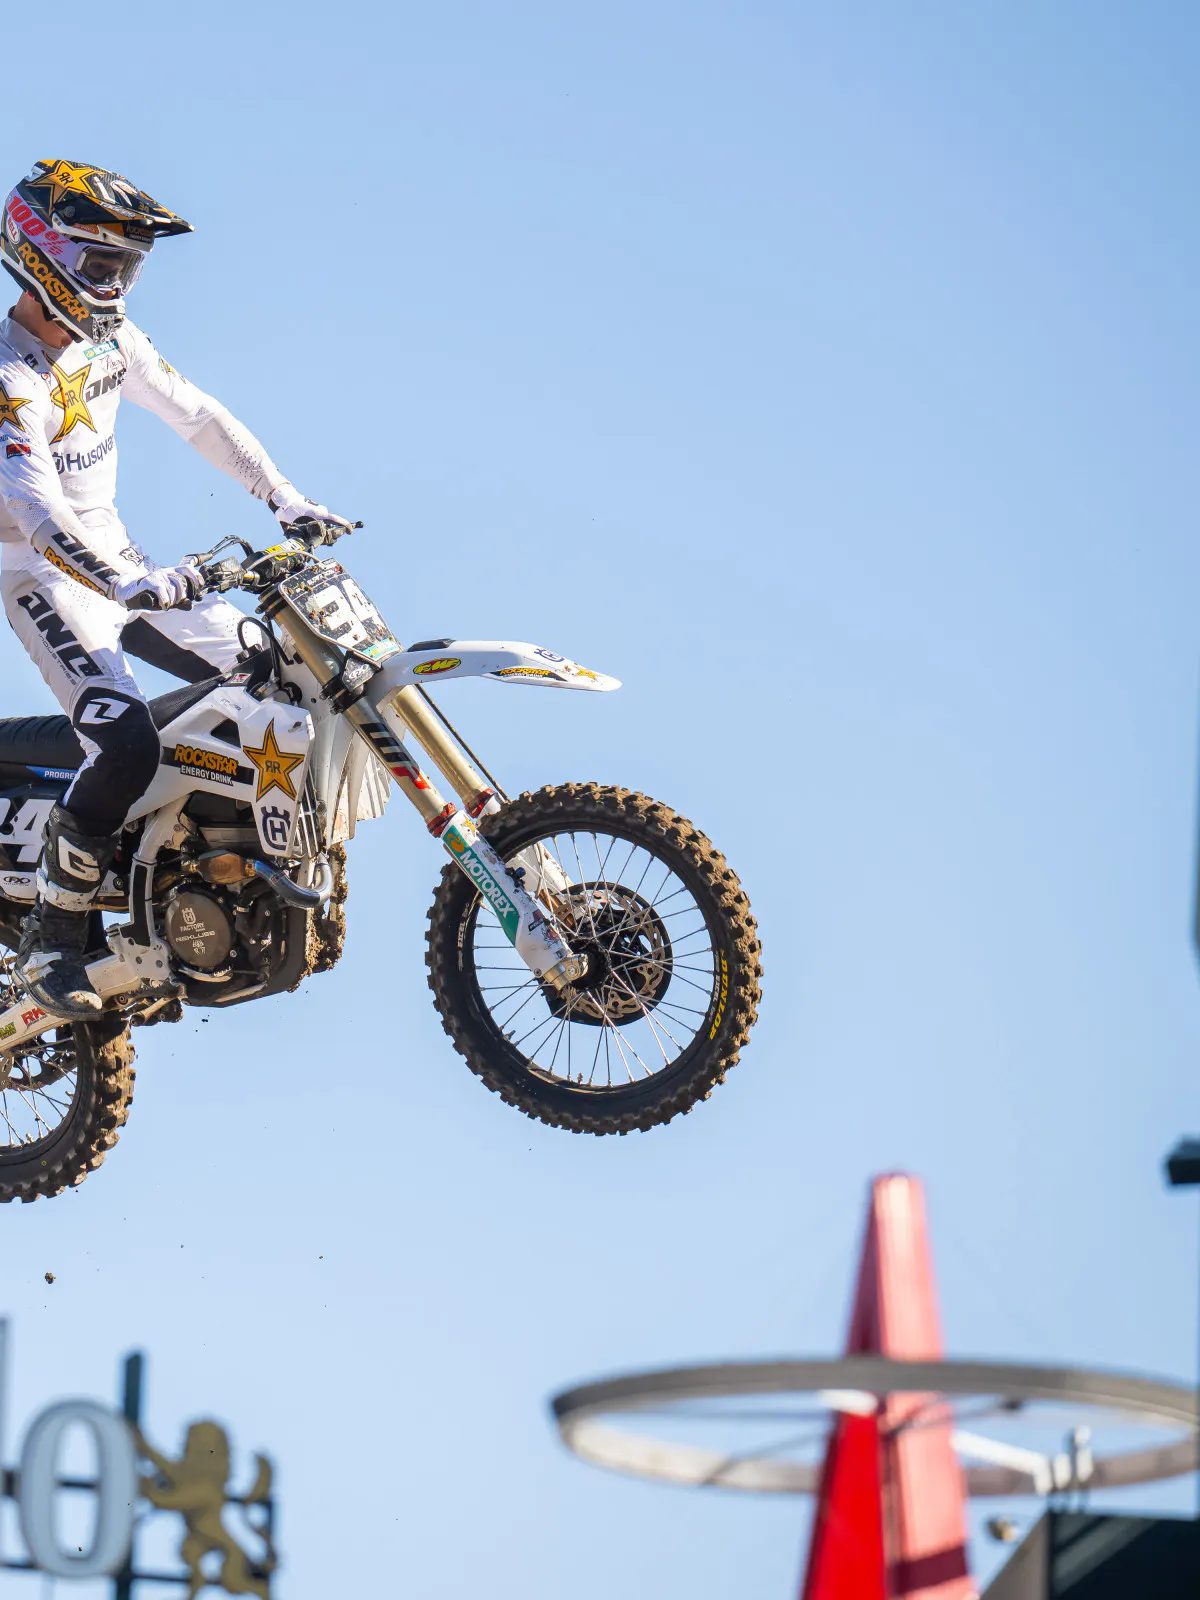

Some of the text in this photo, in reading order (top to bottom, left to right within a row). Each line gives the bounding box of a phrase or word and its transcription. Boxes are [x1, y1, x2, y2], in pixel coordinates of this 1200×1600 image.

[17, 242, 90, 322] ROCKSTAR
[66, 434, 114, 472] Husqva
[44, 770, 76, 780] PROGRE
[174, 744, 239, 776] ROCKSTAR
[181, 765, 210, 780] ENERGY
[460, 850, 515, 918] MOTOREX
[708, 958, 729, 1041] DUNLOP
